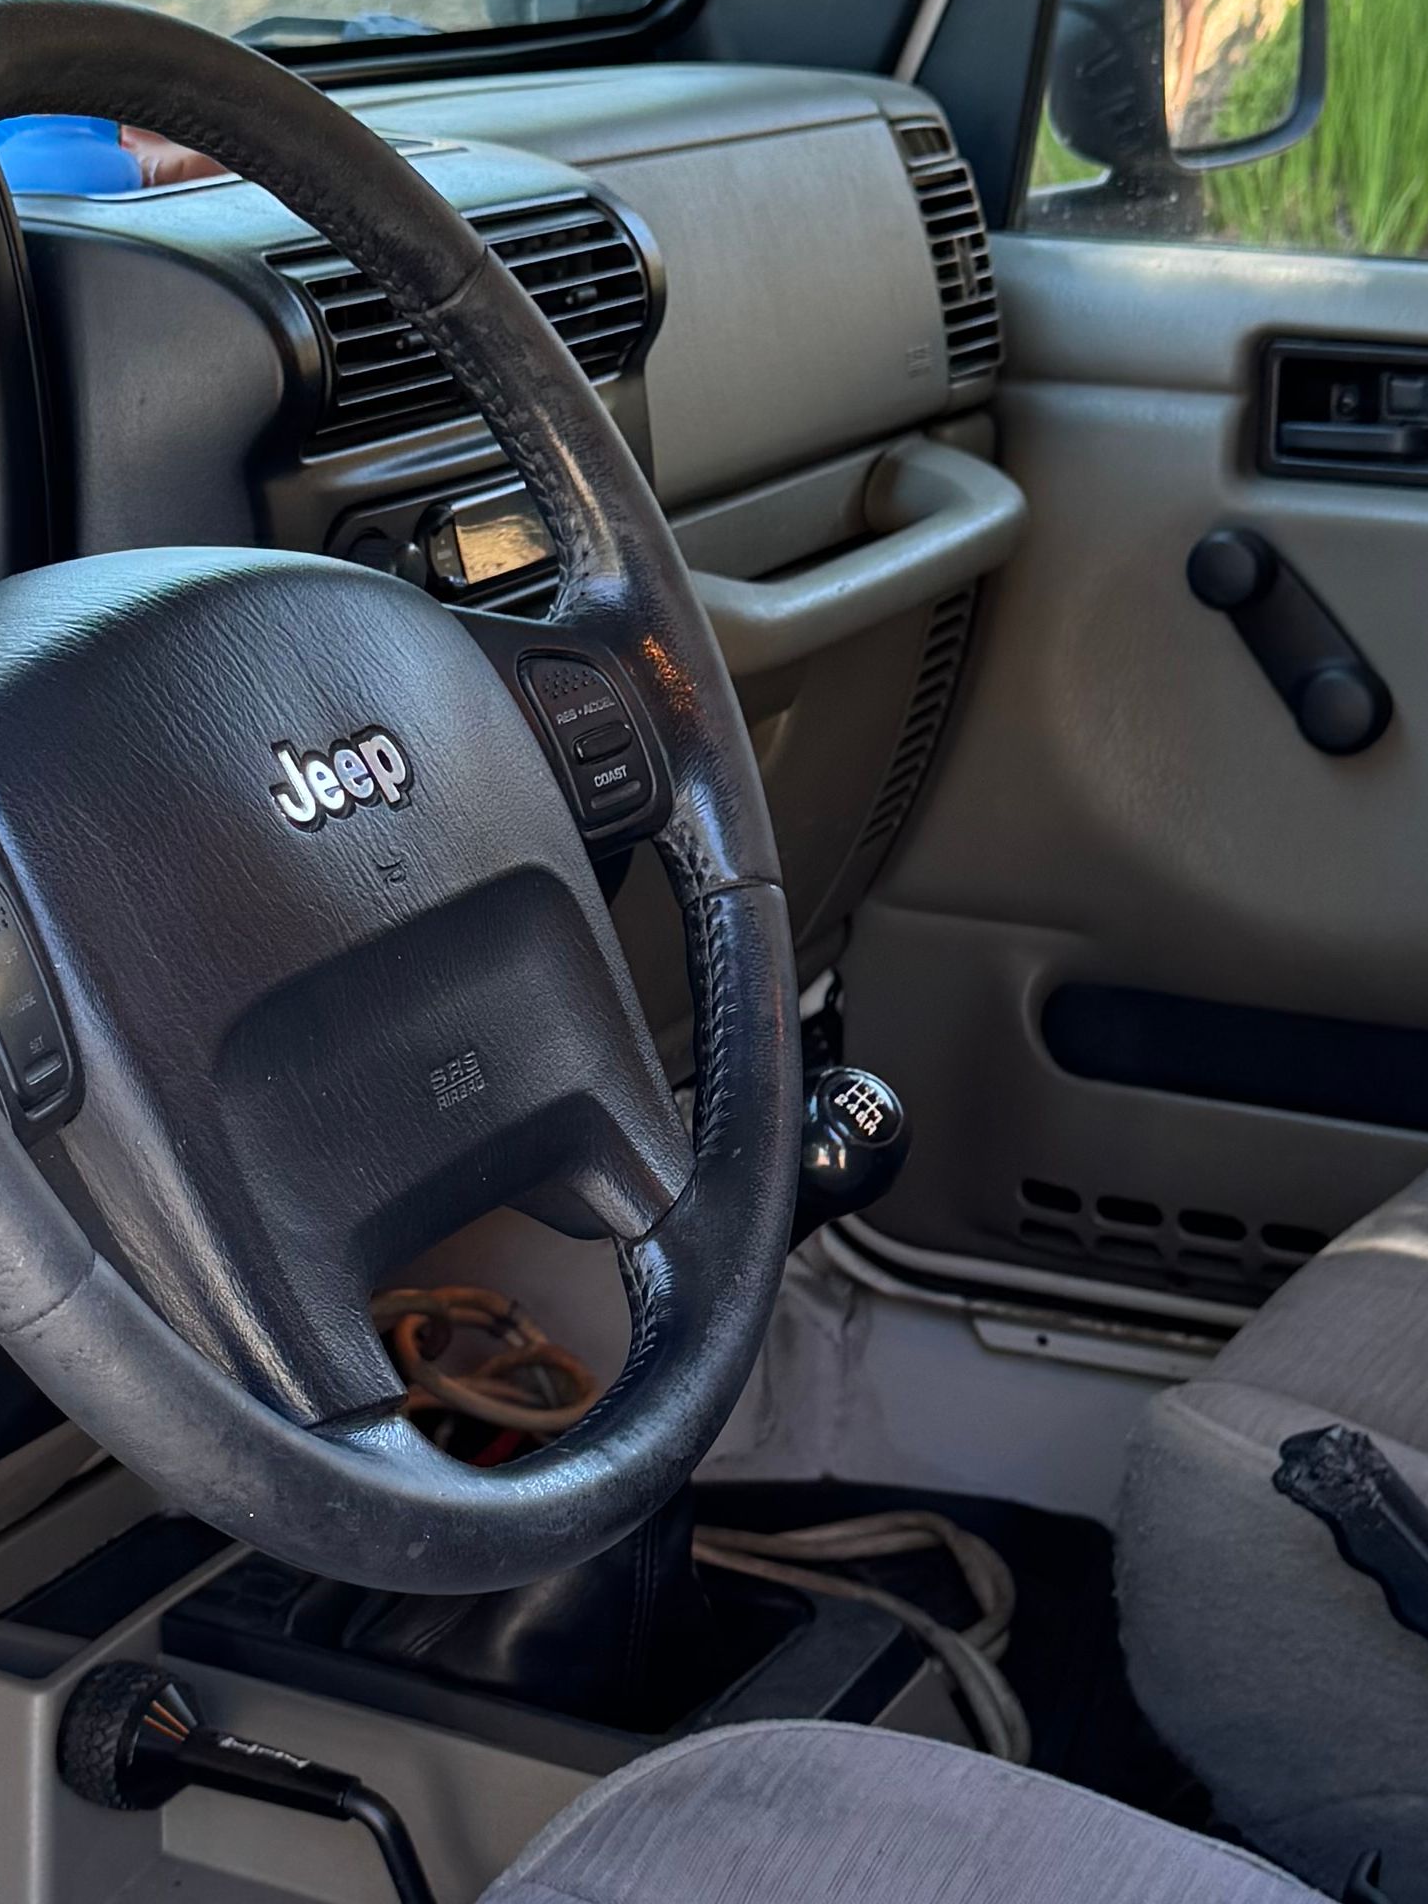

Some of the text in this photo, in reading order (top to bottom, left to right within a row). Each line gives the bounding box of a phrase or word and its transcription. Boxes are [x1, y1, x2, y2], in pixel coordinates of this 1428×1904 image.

[272, 728, 409, 826] Jeep
[593, 763, 628, 788] COAST
[429, 1049, 480, 1091] SRS
